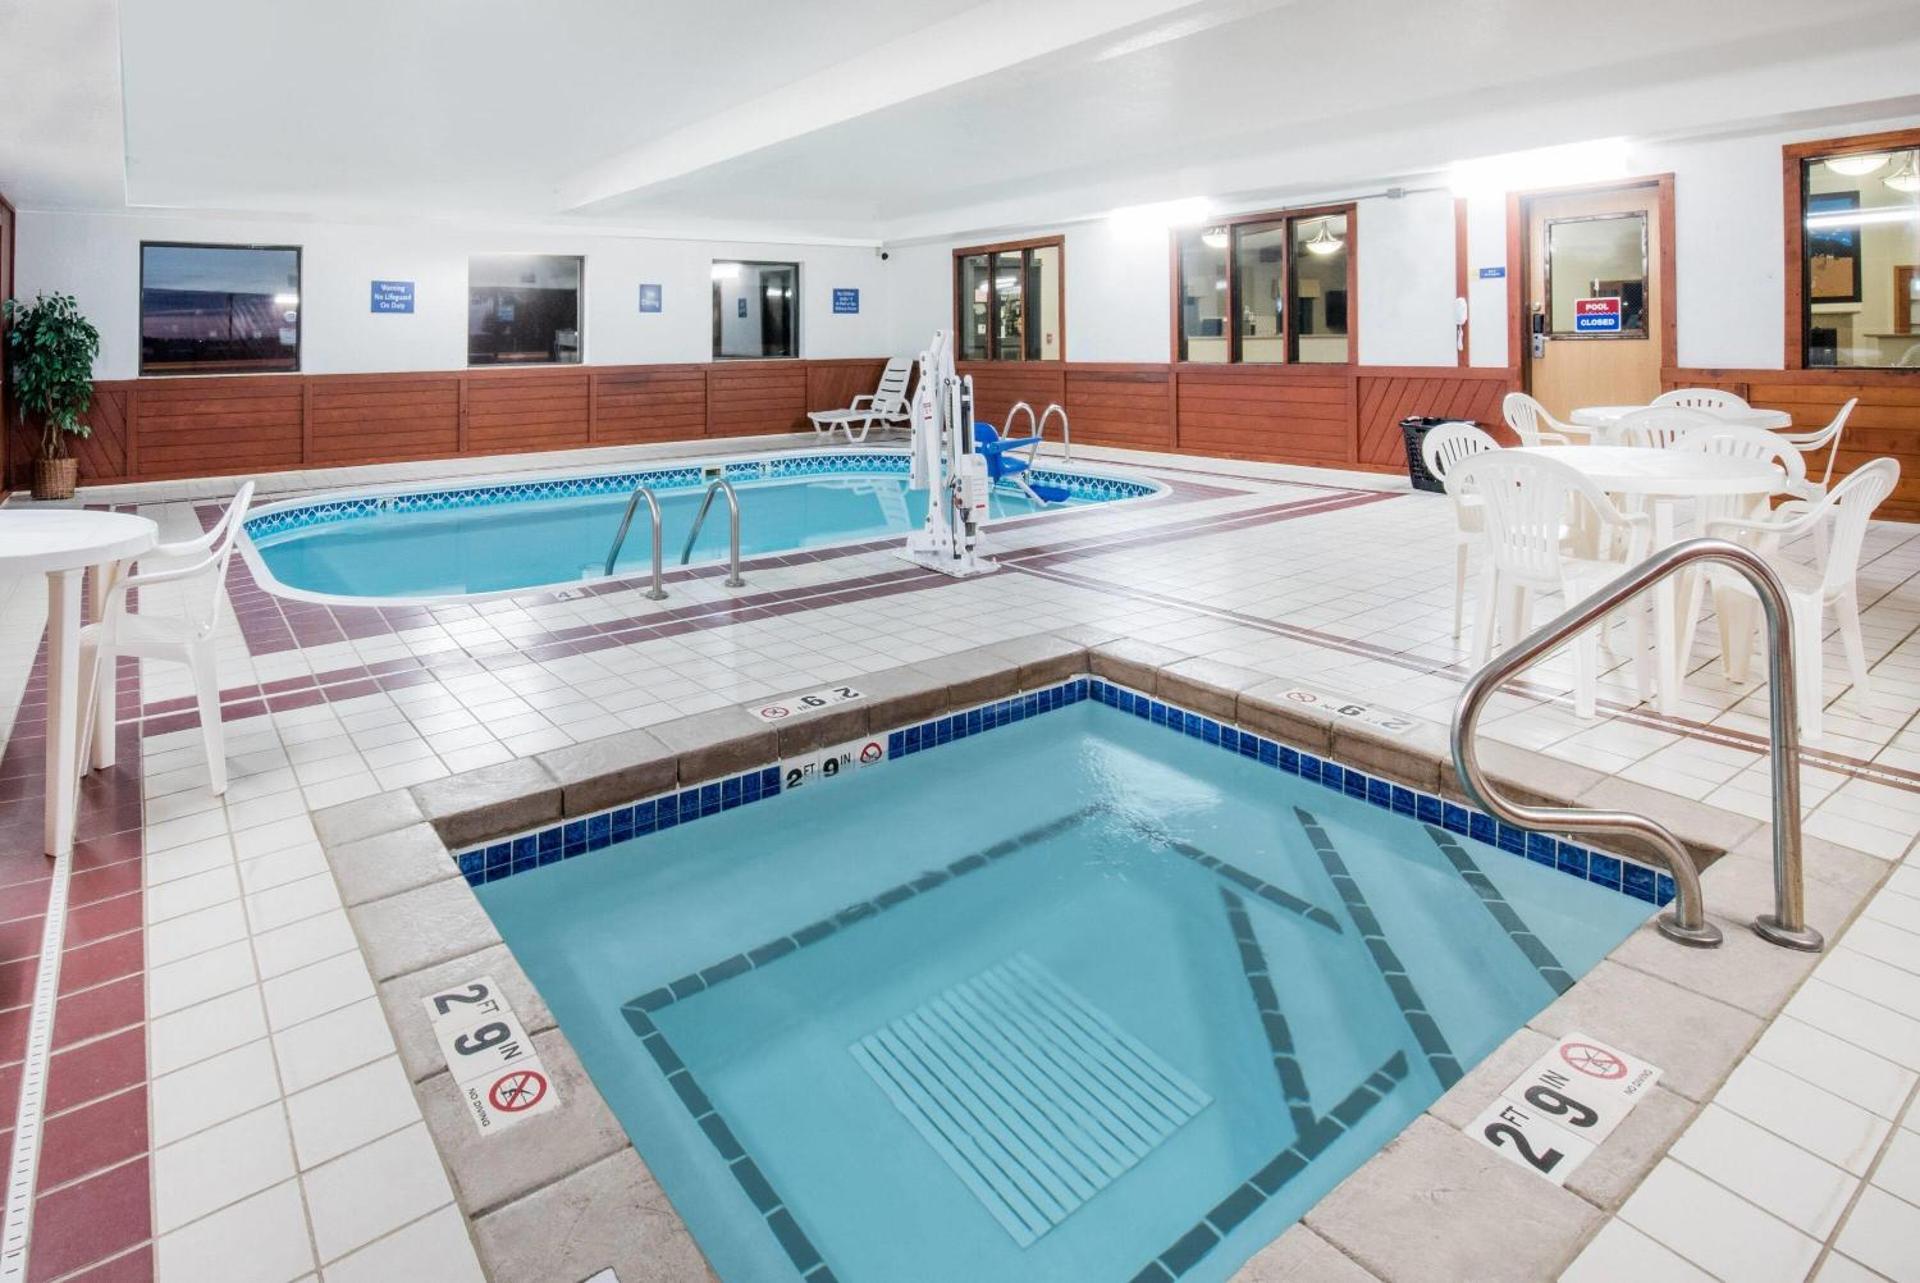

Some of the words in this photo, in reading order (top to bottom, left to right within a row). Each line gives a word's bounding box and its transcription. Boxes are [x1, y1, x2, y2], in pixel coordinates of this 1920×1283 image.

[381, 283, 405, 293] Warning
[385, 293, 411, 302] Lifeguard
[380, 301, 390, 309] On
[391, 301, 405, 310] Duty
[1585, 303, 1609, 311] POOL
[1580, 318, 1615, 327] CLOSED
[833, 687, 860, 699] 2
[786, 768, 803, 789] 2
[803, 763, 816, 777] FT
[823, 758, 839, 777] 9
[840, 752, 851, 766] IN
[433, 984, 489, 1016] 2
[477, 999, 500, 1015] FT
[454, 1021, 511, 1056] 9
[498, 1041, 522, 1061] IN
[1538, 1069, 1570, 1089] IN
[469, 1088, 478, 1100] NO
[473, 1100, 490, 1127] DIVING
[1500, 1105, 1530, 1127] FT
[1524, 1085, 1598, 1127] 9
[1484, 1122, 1565, 1174] 2
